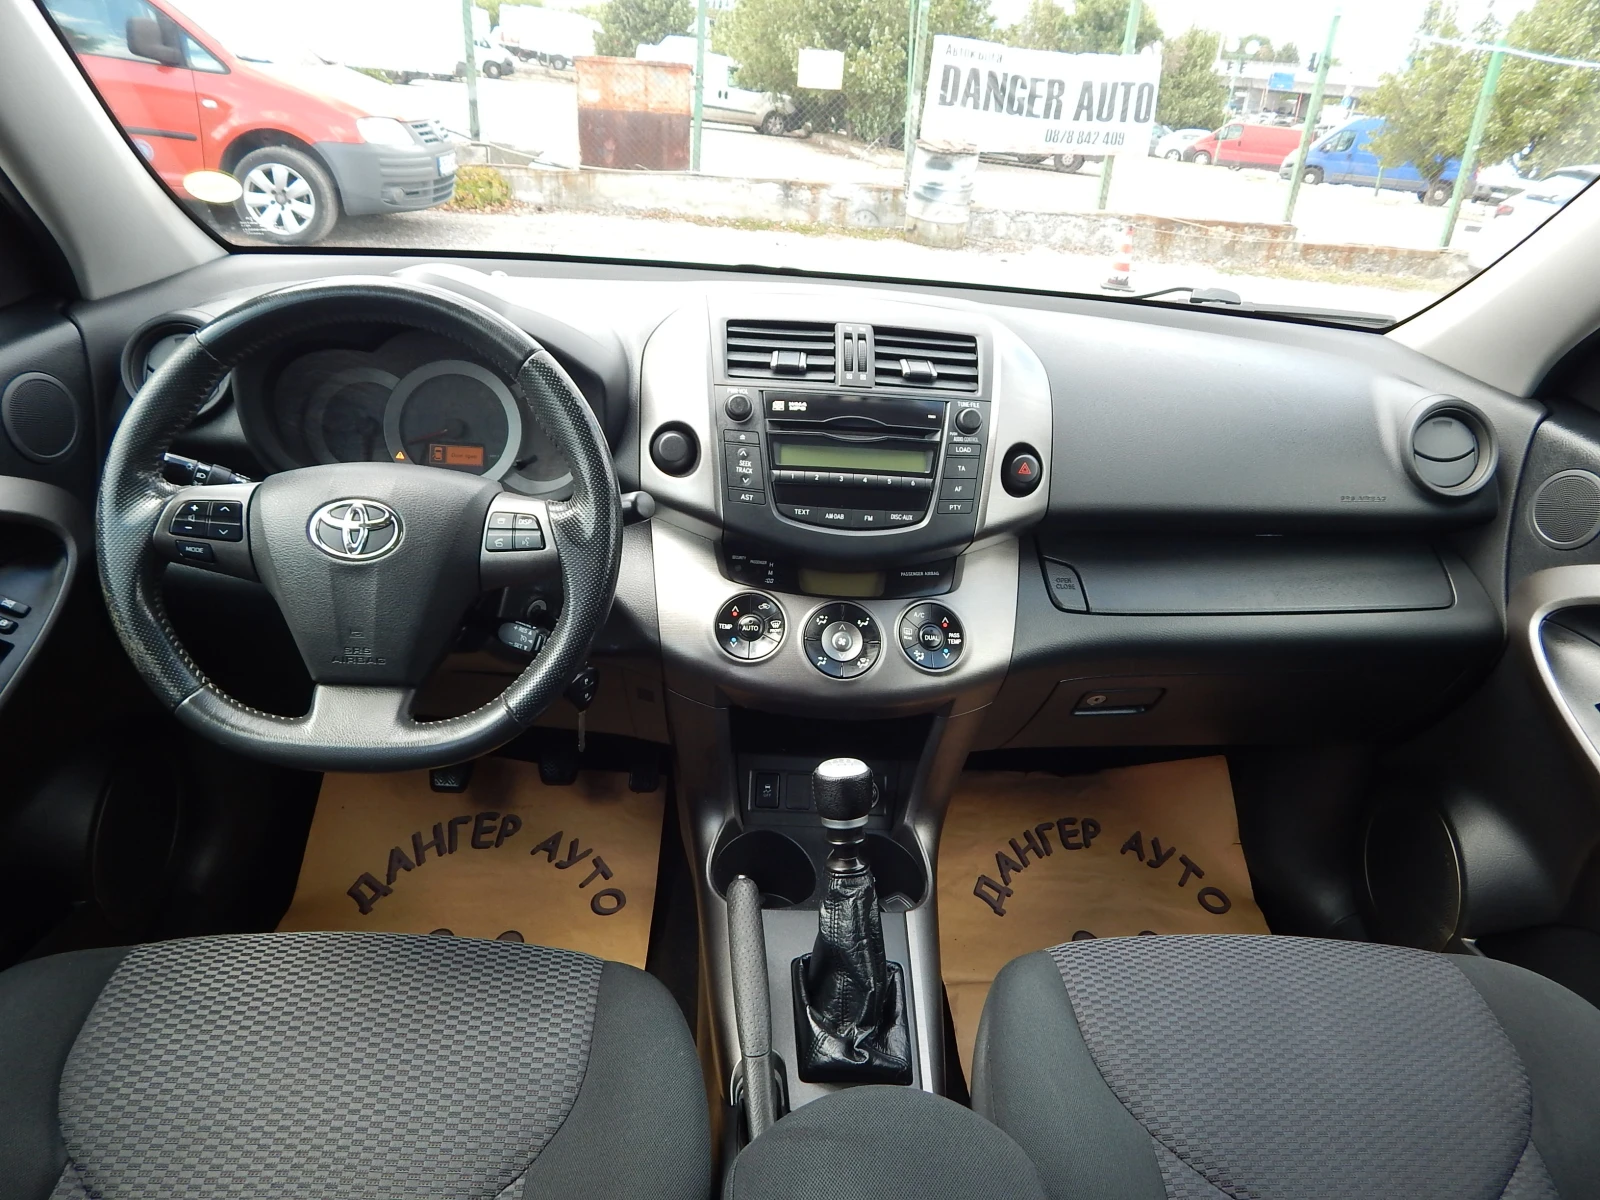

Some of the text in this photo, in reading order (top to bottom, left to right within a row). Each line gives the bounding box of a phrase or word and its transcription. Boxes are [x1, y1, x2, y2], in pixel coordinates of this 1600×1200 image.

[938, 64, 1154, 123] DANGER AUTO
[1077, 130, 1100, 145] 842
[1102, 131, 1125, 146] 409
[331, 656, 386, 665] AIRBAG
[344, 646, 371, 655] SRS
[347, 812, 627, 916] ДАНГЕР АУТО
[973, 817, 1232, 917] ДАНГЕР АУТО
